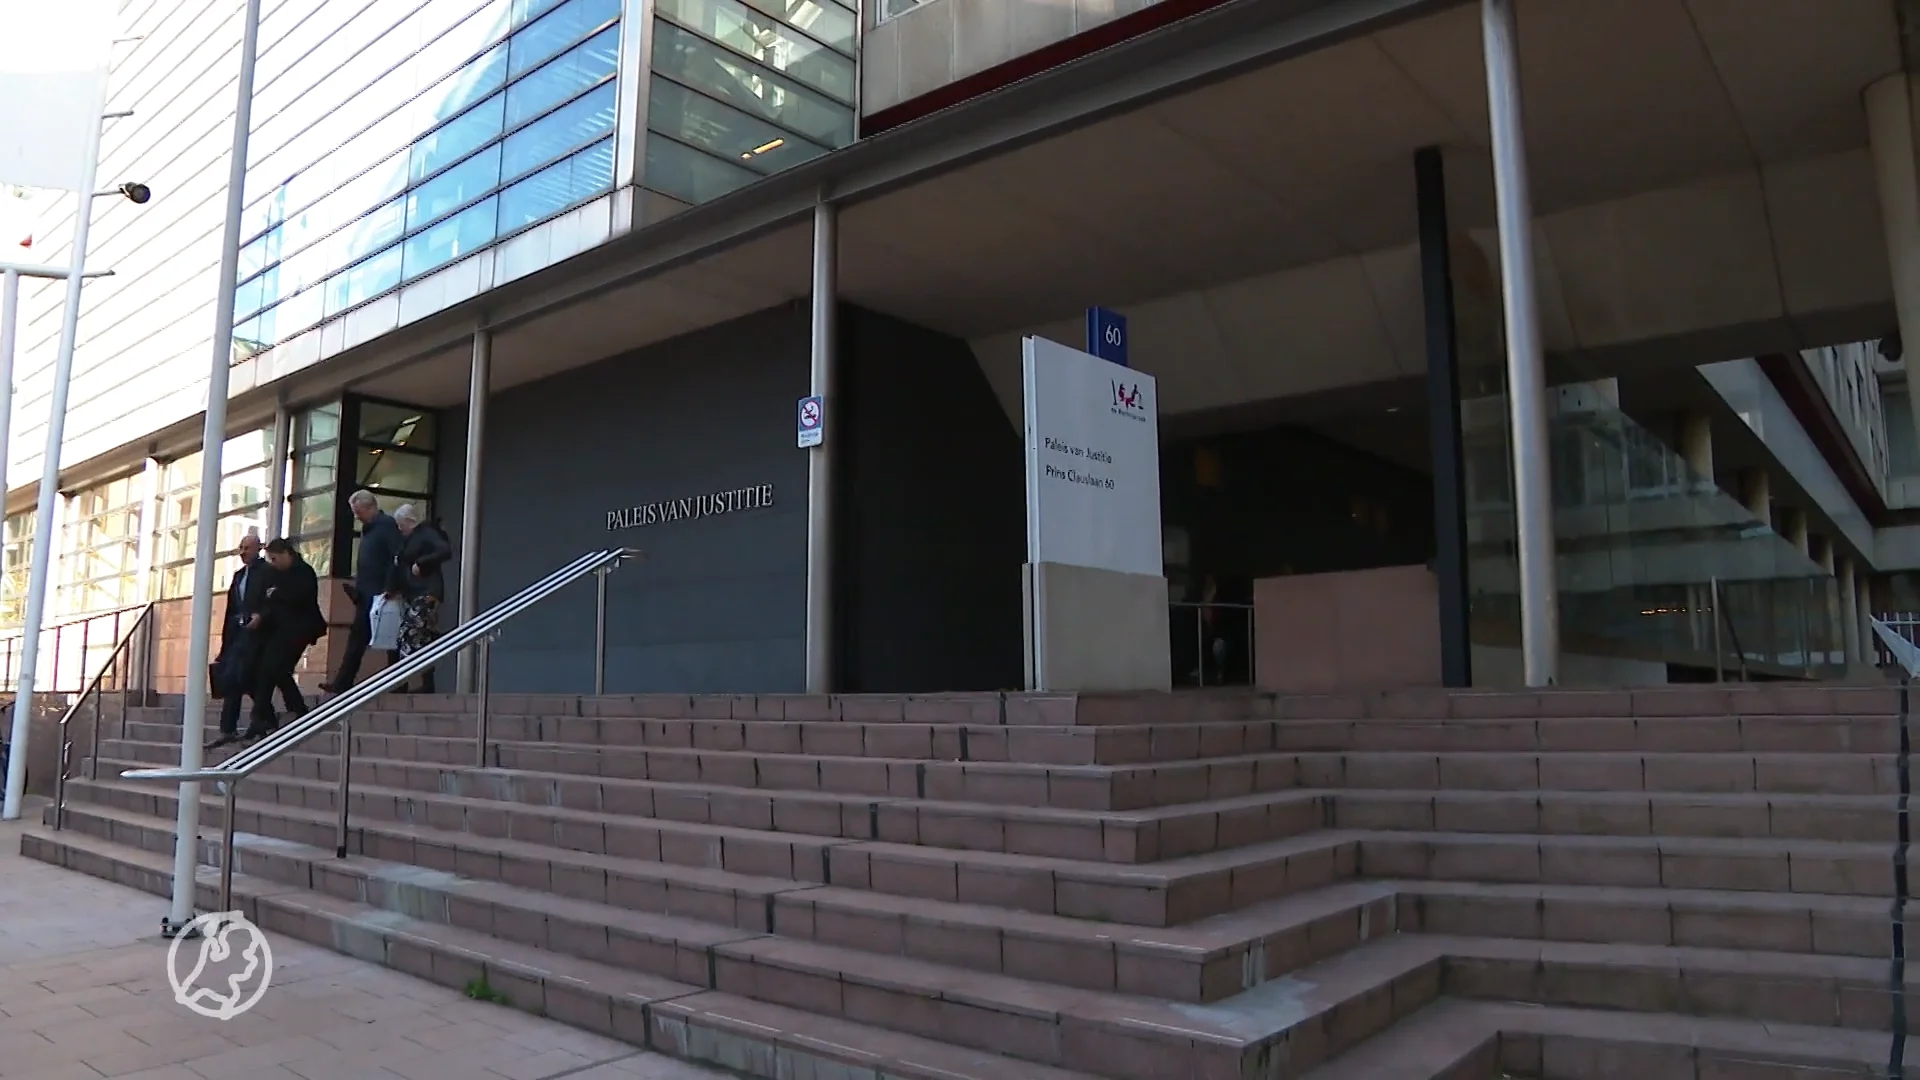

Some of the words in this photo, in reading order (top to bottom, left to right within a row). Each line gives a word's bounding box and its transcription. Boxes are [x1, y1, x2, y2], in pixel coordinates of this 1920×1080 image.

[1105, 324, 1122, 347] 60
[1044, 437, 1068, 454] Paleis
[1069, 447, 1084, 457] van
[1046, 465, 1066, 480] Prins
[1067, 469, 1103, 489] Clauslaan
[1104, 478, 1115, 490] 60
[607, 503, 657, 530] PALEIS
[658, 497, 692, 523] VAN
[694, 484, 773, 520] JUSTITIE
